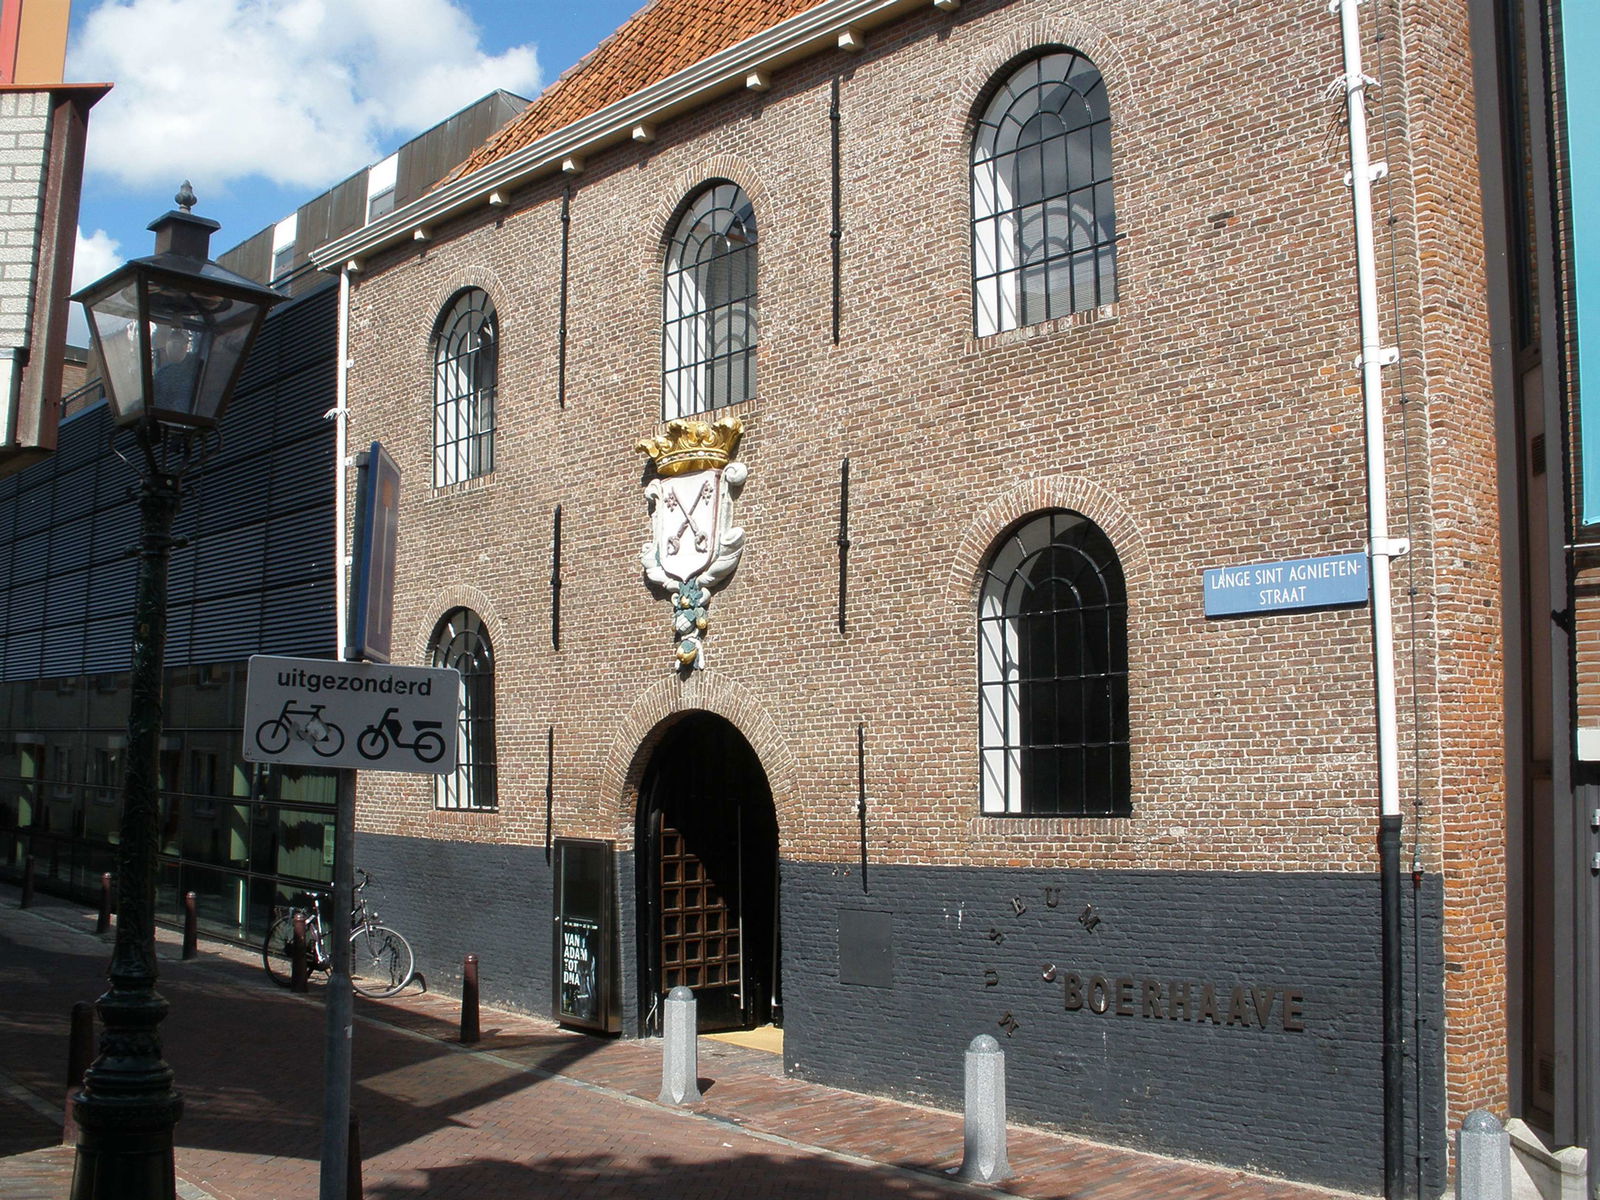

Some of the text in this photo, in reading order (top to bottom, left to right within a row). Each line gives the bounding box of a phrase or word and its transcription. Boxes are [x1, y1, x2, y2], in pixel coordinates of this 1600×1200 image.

[1211, 560, 1362, 590] LANGE SINT AGNIETEN-
[1259, 586, 1307, 606] STRAAT
[278, 668, 432, 696] uitgezonderd
[564, 932, 581, 947] VAN
[563, 945, 588, 962] ADAM
[984, 886, 1101, 1038] MUSEUM
[563, 958, 579, 973] TOT
[563, 971, 581, 986] DNA
[1064, 972, 1304, 1032] BOERHAAVE
